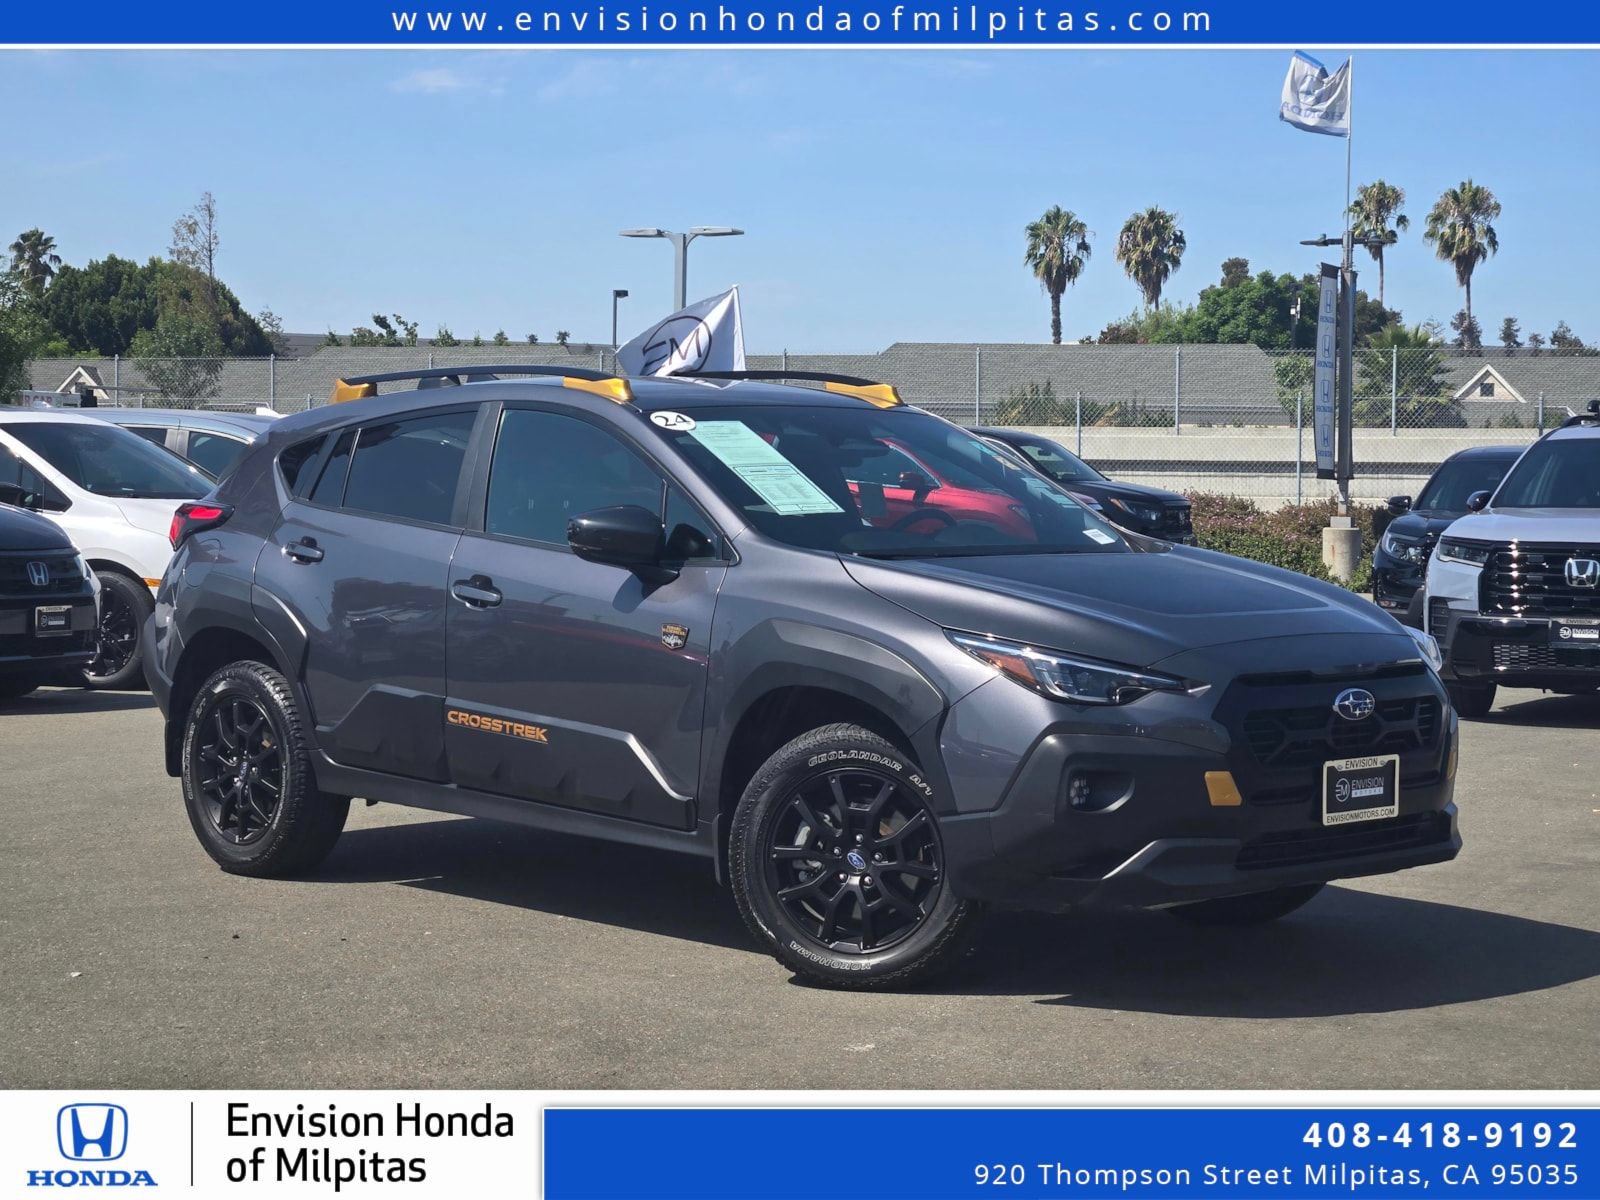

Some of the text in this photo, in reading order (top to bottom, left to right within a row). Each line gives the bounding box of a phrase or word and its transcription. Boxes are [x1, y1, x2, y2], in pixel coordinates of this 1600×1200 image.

[654, 414, 692, 427] 24
[447, 710, 549, 742] CROSSTREK
[808, 750, 903, 772] GEOLANDAR
[1345, 758, 1378, 769] ENVISION
[1351, 777, 1385, 789] ENVISION
[1326, 808, 1395, 823] ENVISIONMOTORS.COM
[789, 940, 872, 971] YOKOHAMA
